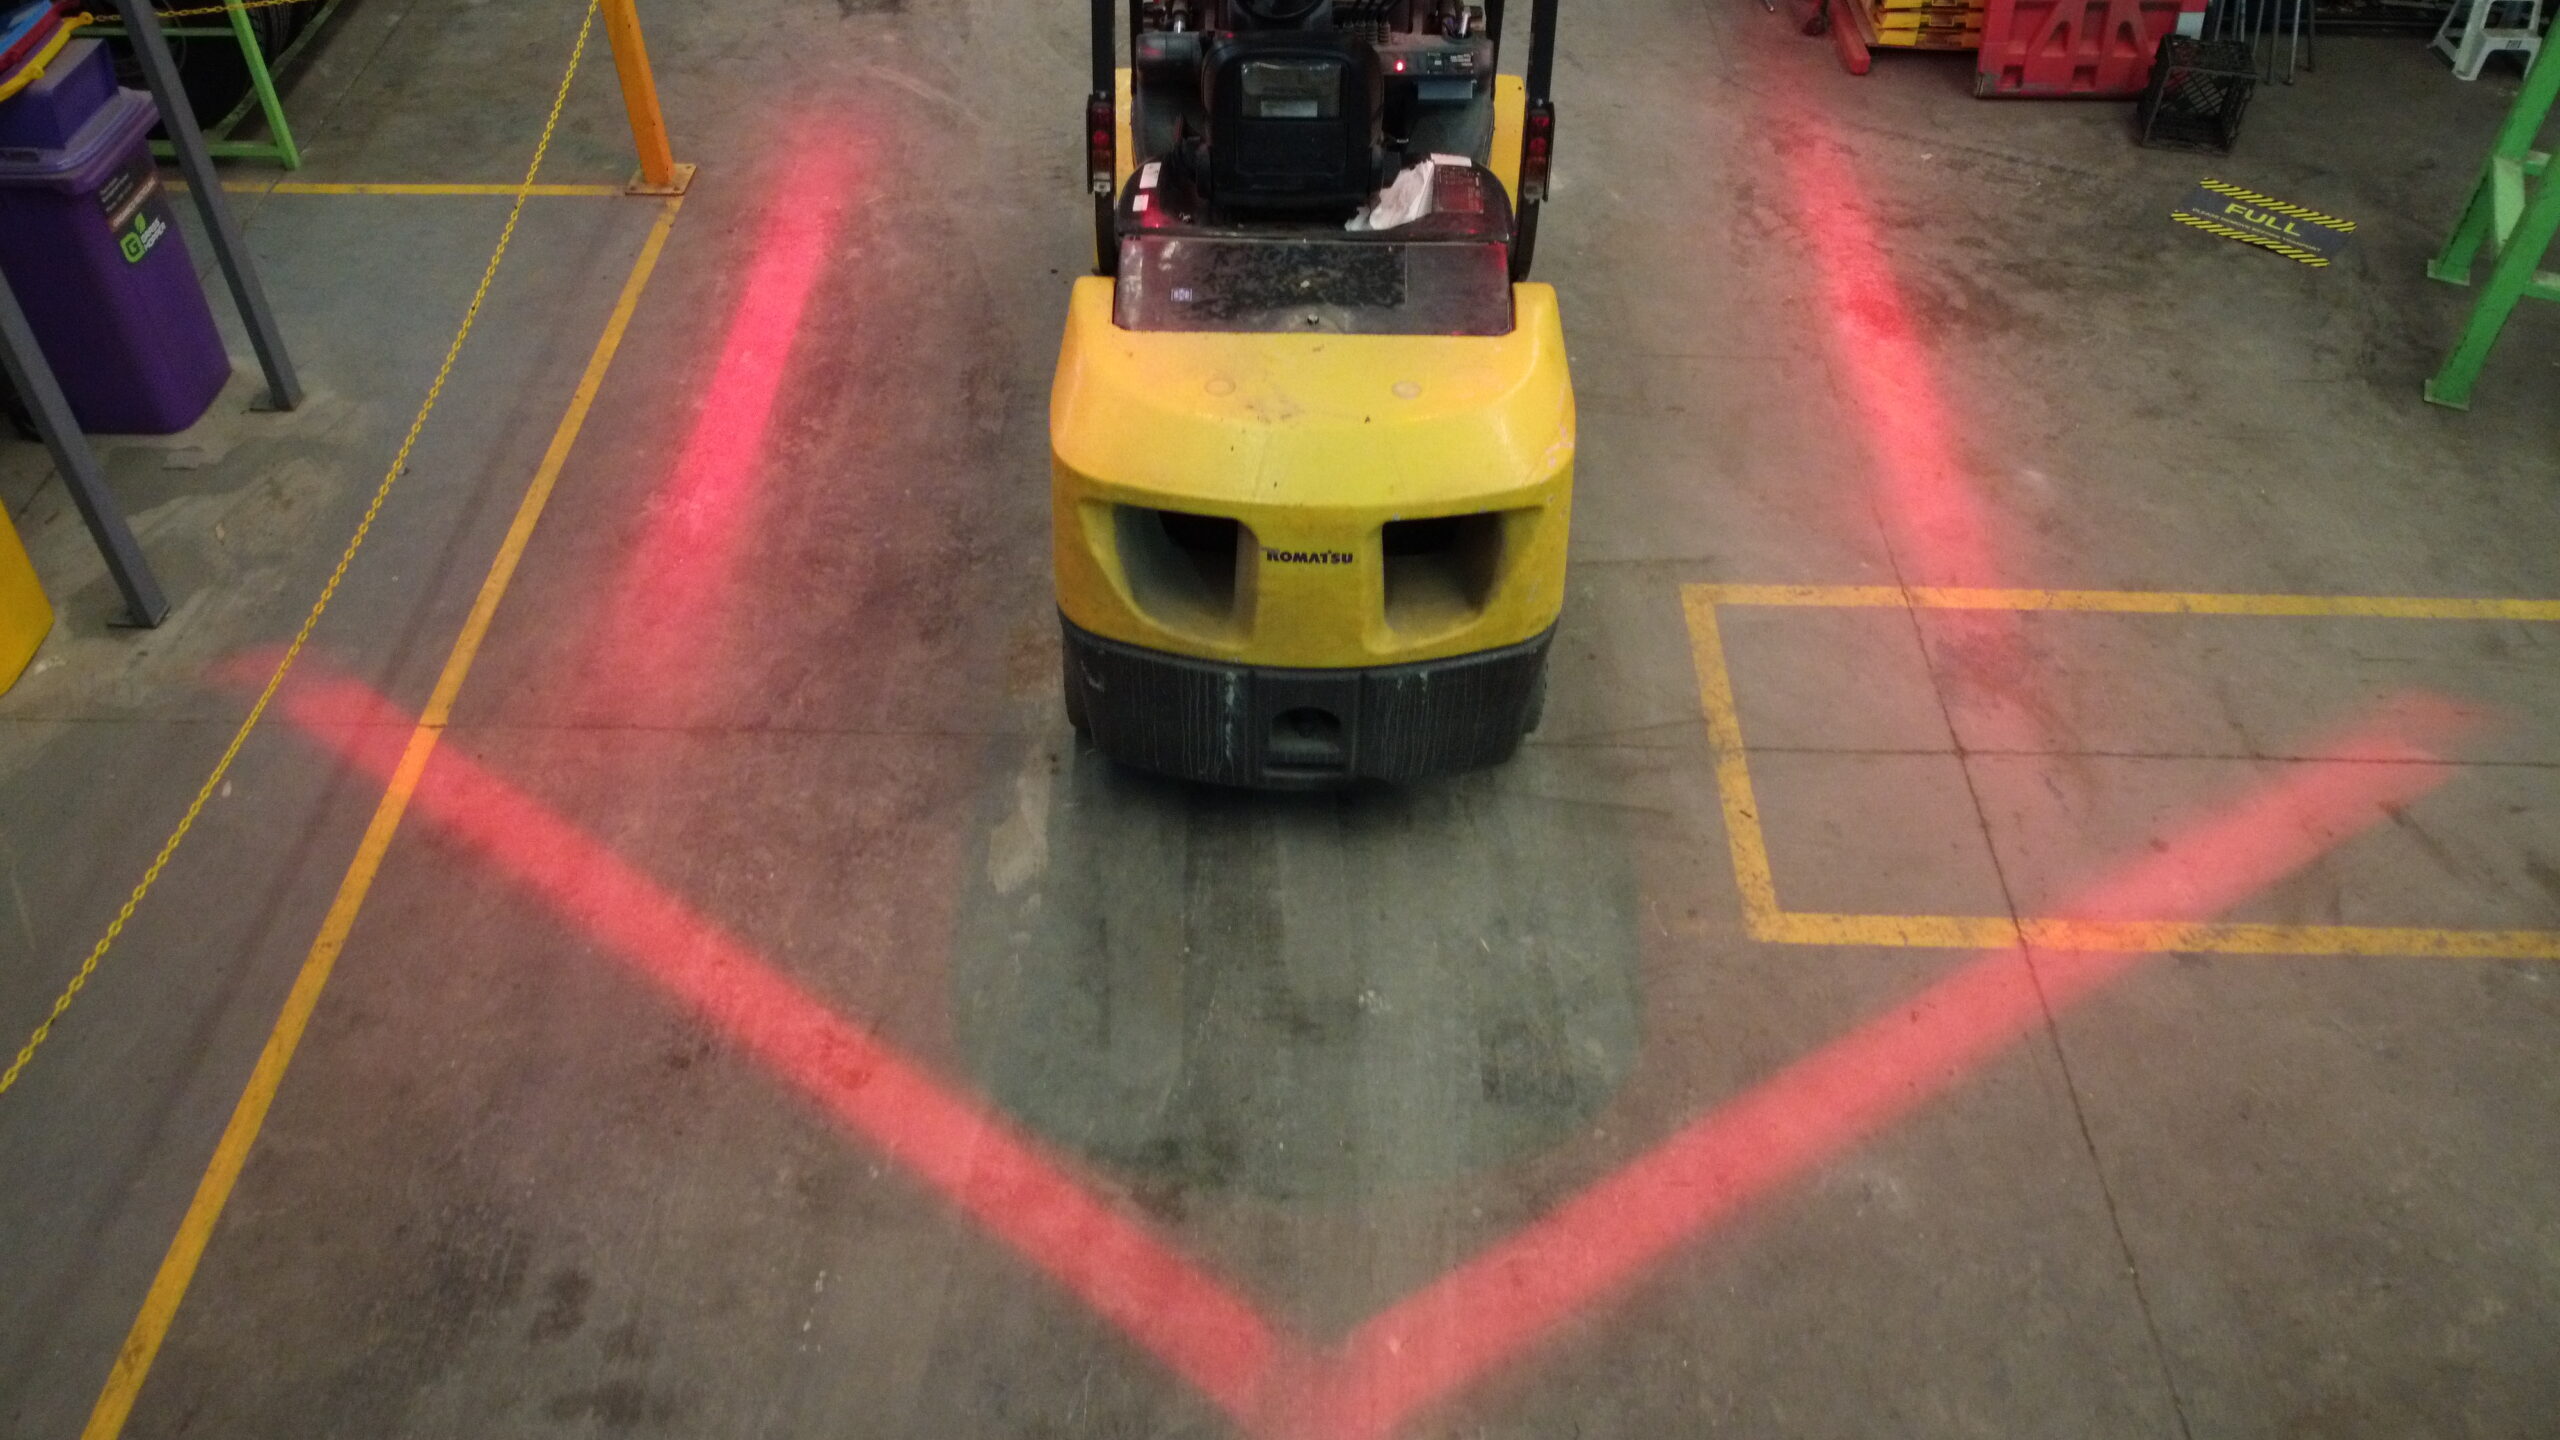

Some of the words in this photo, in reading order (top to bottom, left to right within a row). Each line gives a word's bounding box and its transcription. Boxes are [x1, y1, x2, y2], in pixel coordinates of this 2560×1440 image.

[2192, 207, 2220, 219] PLEASE
[2220, 216, 2251, 230] REMOVE
[2224, 203, 2301, 237] FULL
[1266, 550, 1353, 564] KOMATSU
